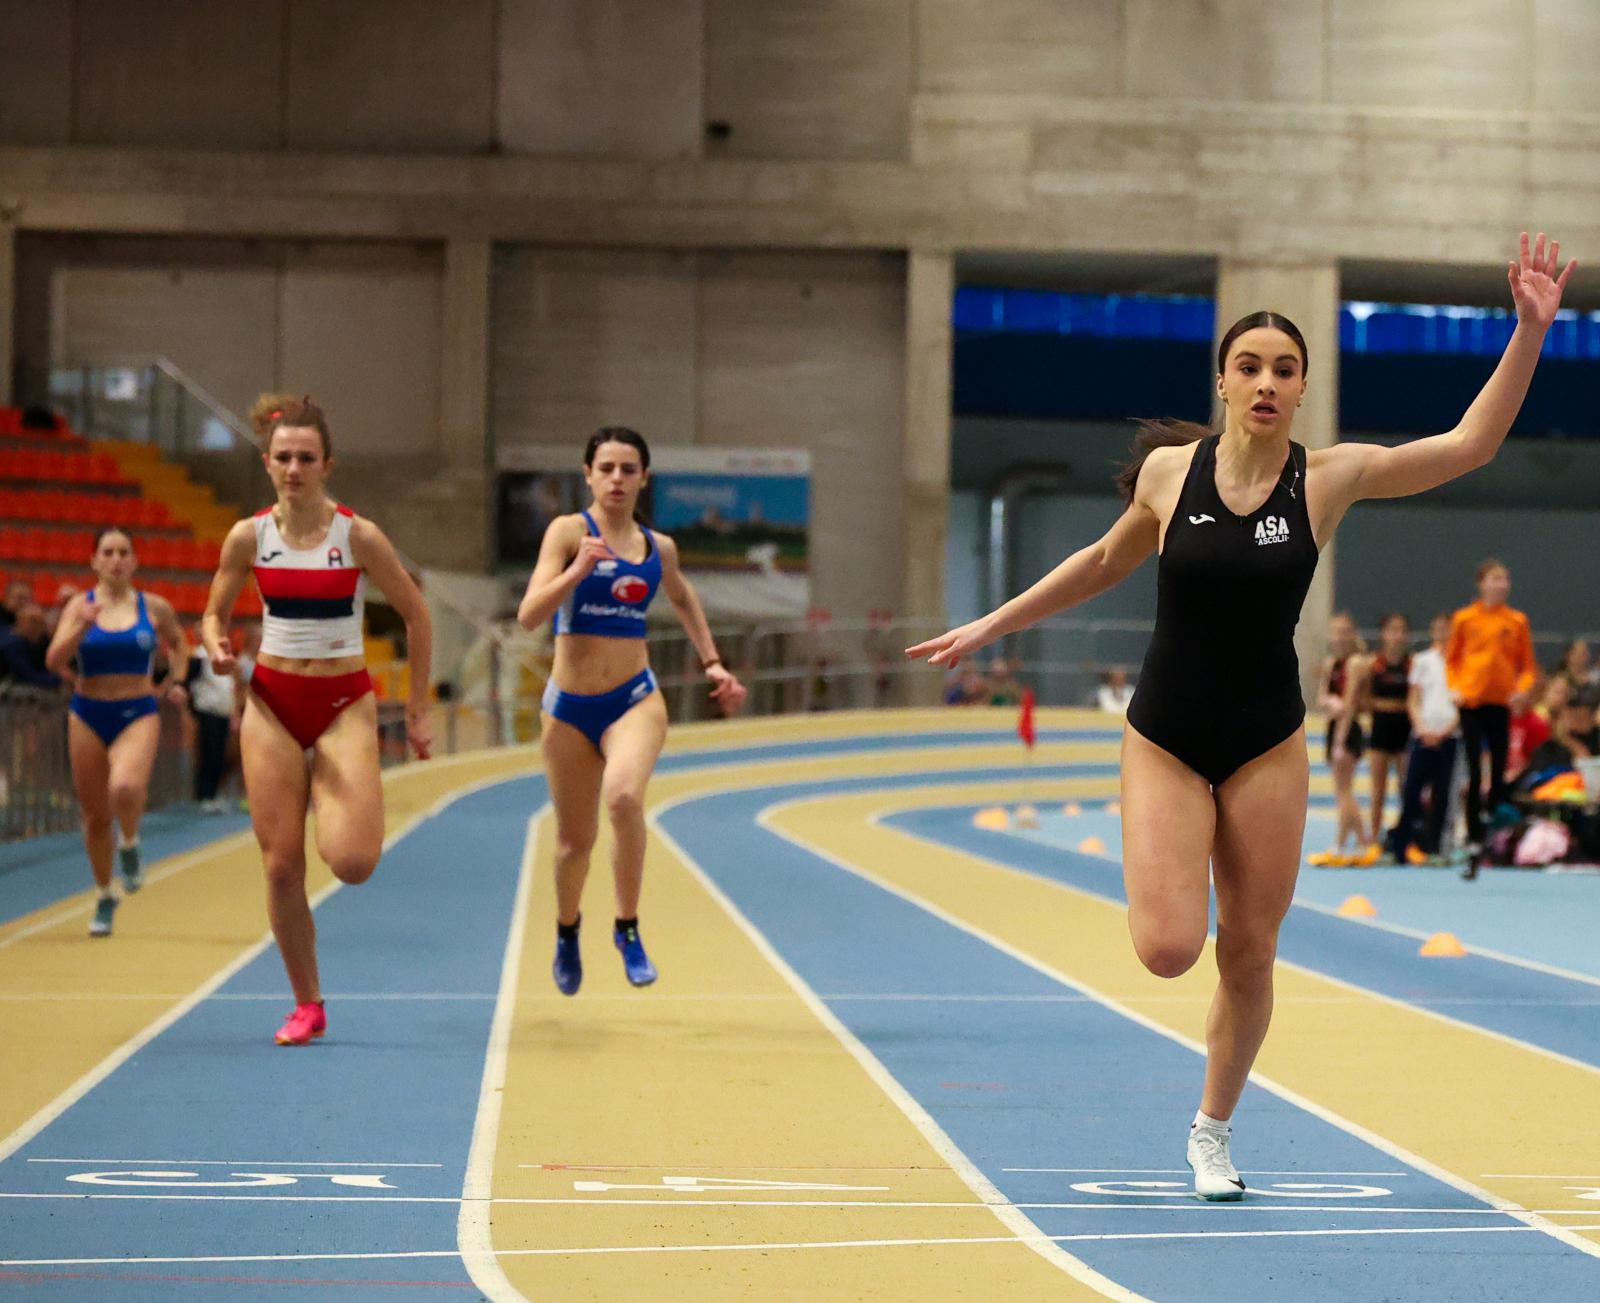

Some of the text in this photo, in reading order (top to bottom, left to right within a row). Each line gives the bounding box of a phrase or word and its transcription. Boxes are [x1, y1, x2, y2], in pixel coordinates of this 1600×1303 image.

[1255, 515, 1290, 539] ASA
[65, 1171, 399, 1189] 5
[574, 1176, 889, 1192] 4
[1069, 1181, 1393, 1198] 3
